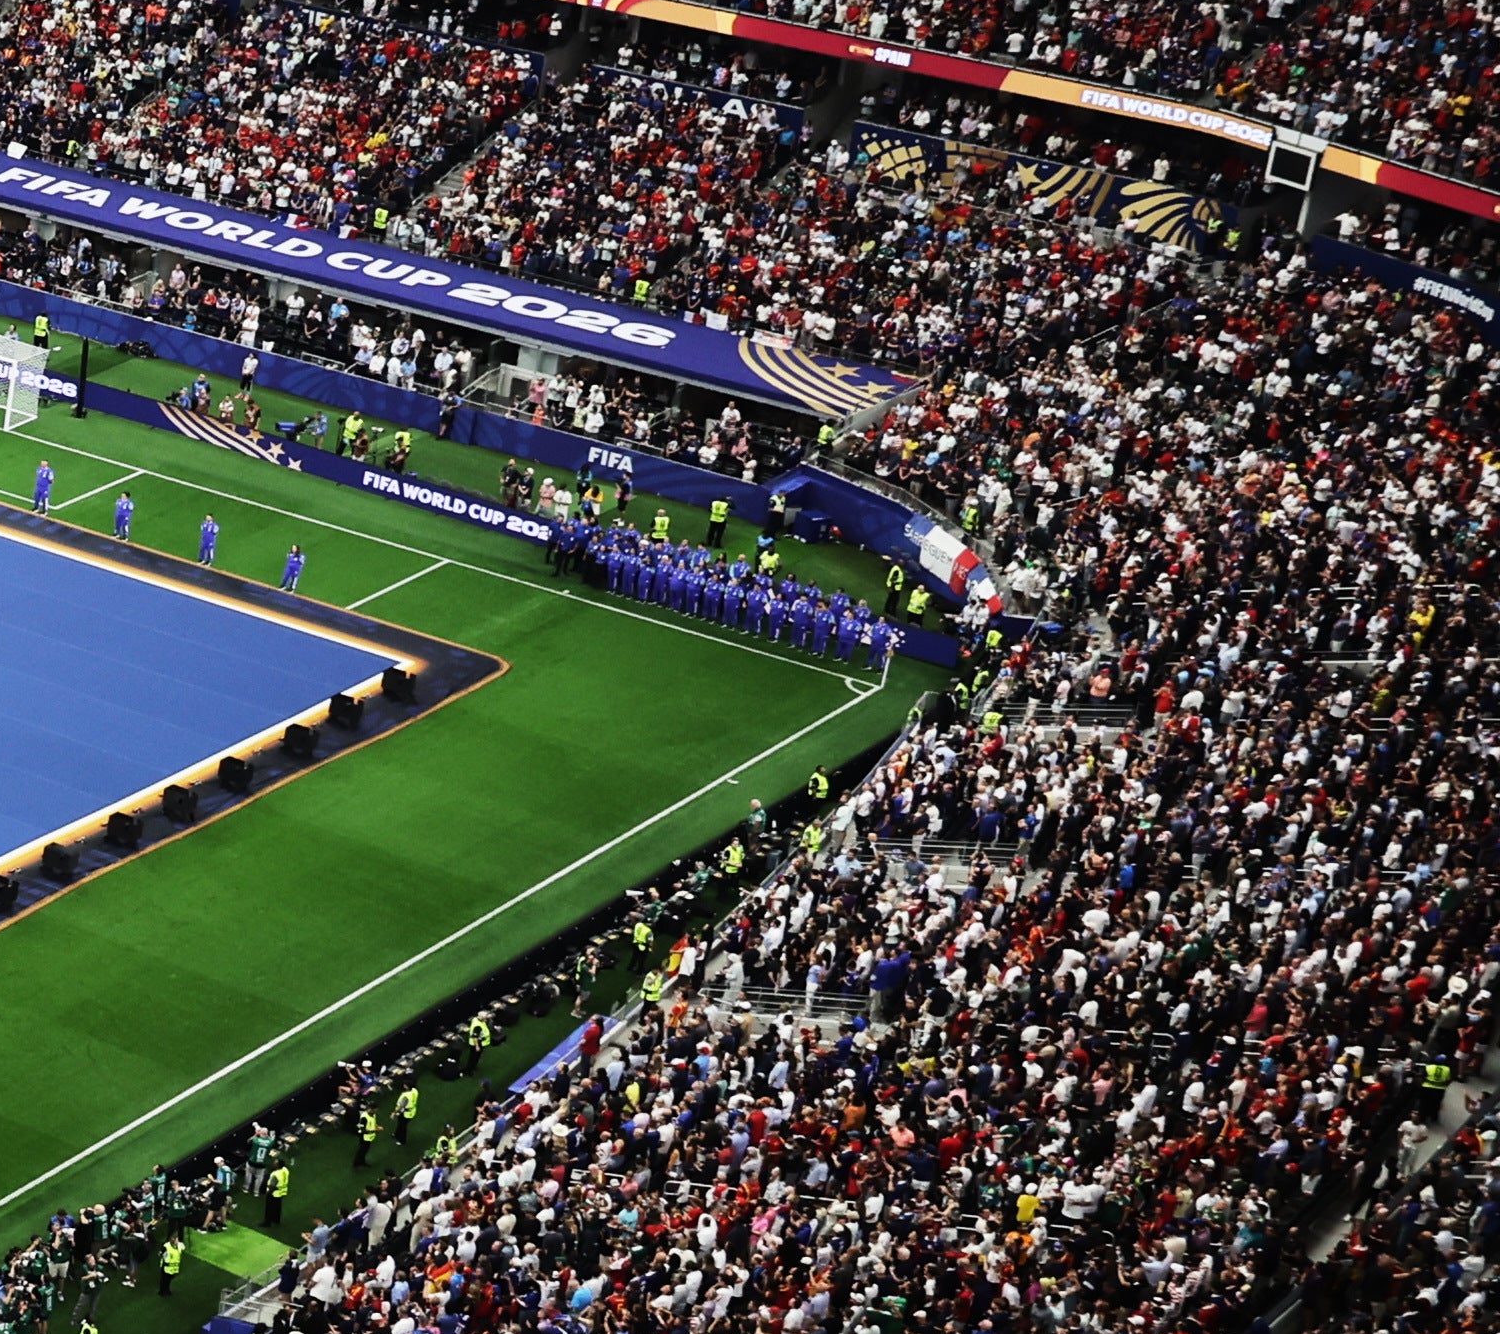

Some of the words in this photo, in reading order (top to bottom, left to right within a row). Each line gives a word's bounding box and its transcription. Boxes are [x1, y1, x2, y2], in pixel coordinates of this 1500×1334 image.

[874, 47, 912, 67] SPAIN
[1081, 89, 1120, 108] FIFA
[1122, 97, 1191, 122] WORLD
[1191, 111, 1228, 130] CUP
[118, 195, 323, 258] WORLD
[326, 250, 451, 288] CUP
[447, 281, 678, 347] 2026
[20, 369, 78, 397] 2026
[588, 446, 633, 474] FIFA
[362, 471, 399, 496] FIFA
[402, 481, 467, 515] WORLD
[468, 498, 505, 527] CUP
